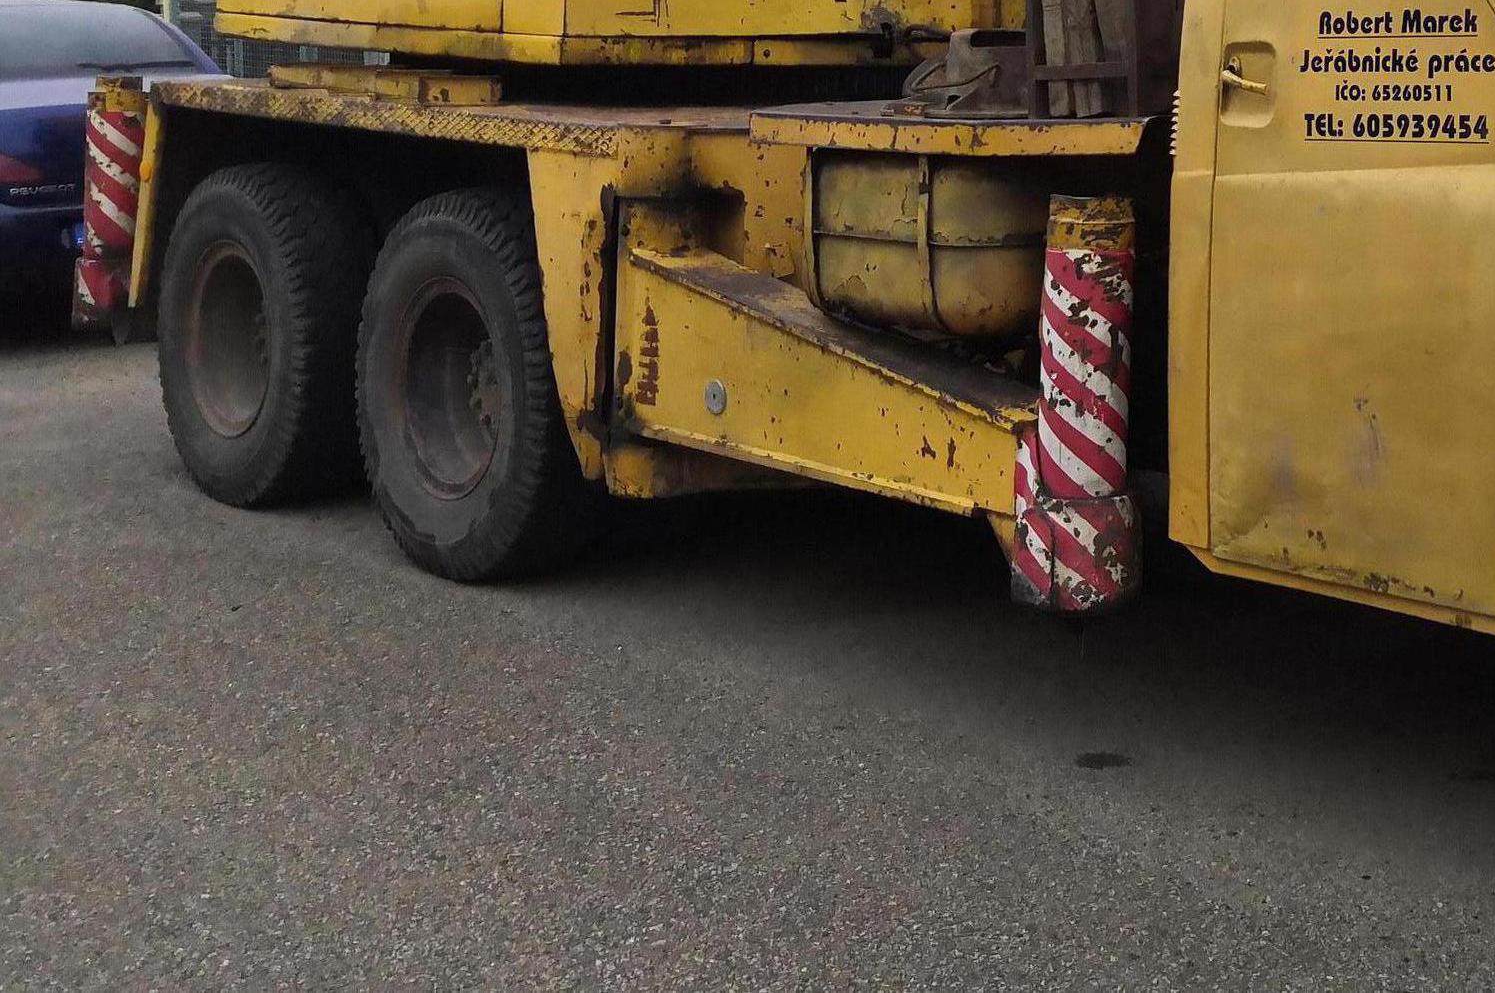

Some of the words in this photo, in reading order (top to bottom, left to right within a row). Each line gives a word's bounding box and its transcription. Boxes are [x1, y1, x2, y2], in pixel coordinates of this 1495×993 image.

[1318, 9, 1393, 35] Robert
[1401, 8, 1478, 34] Marek
[1300, 46, 1419, 74] Jeřábnické
[1335, 80, 1366, 102] IČO:
[1372, 84, 1452, 102] 65260511
[1304, 113, 1344, 137] TEL:
[1353, 113, 1489, 139] 605939454
